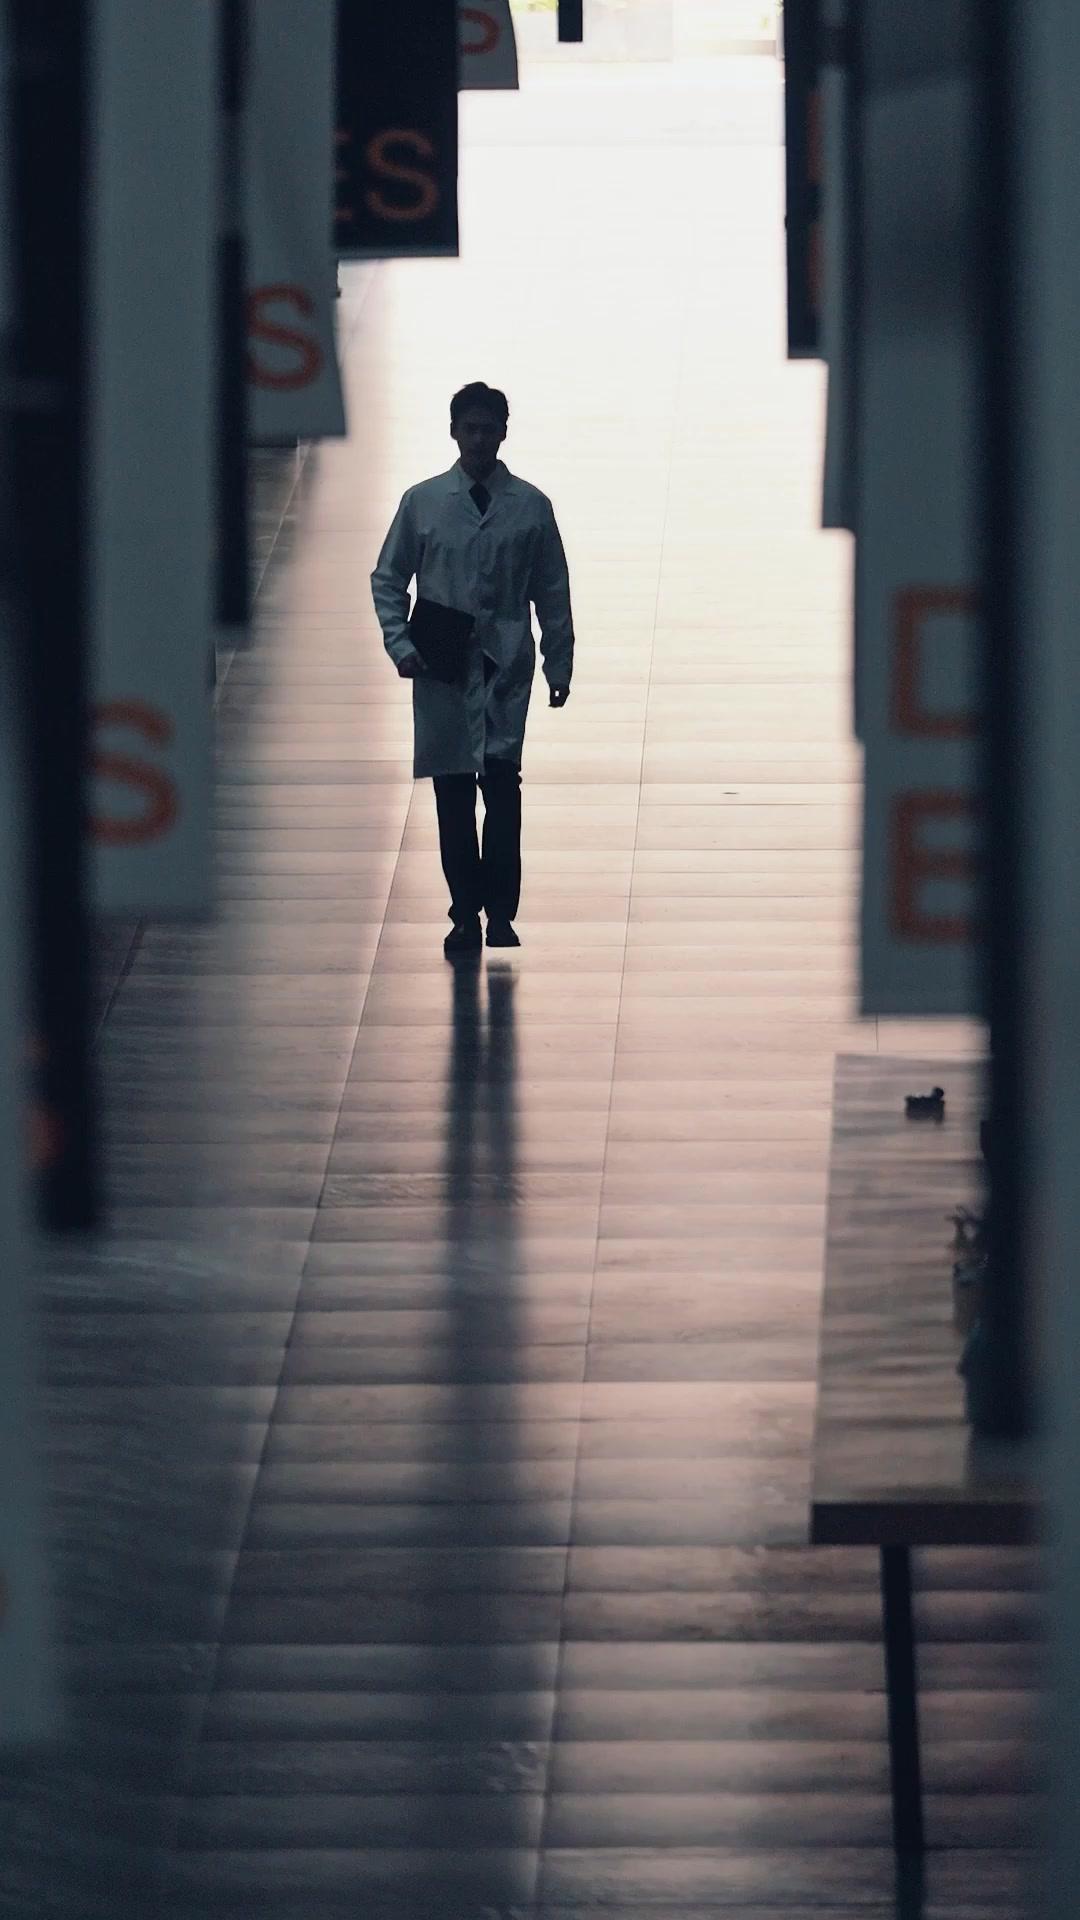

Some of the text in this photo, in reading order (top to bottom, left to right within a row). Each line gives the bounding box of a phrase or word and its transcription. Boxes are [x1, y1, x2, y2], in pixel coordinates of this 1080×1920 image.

[335, 127, 439, 222] S
[245, 284, 323, 390] S
[87, 698, 179, 847] S
